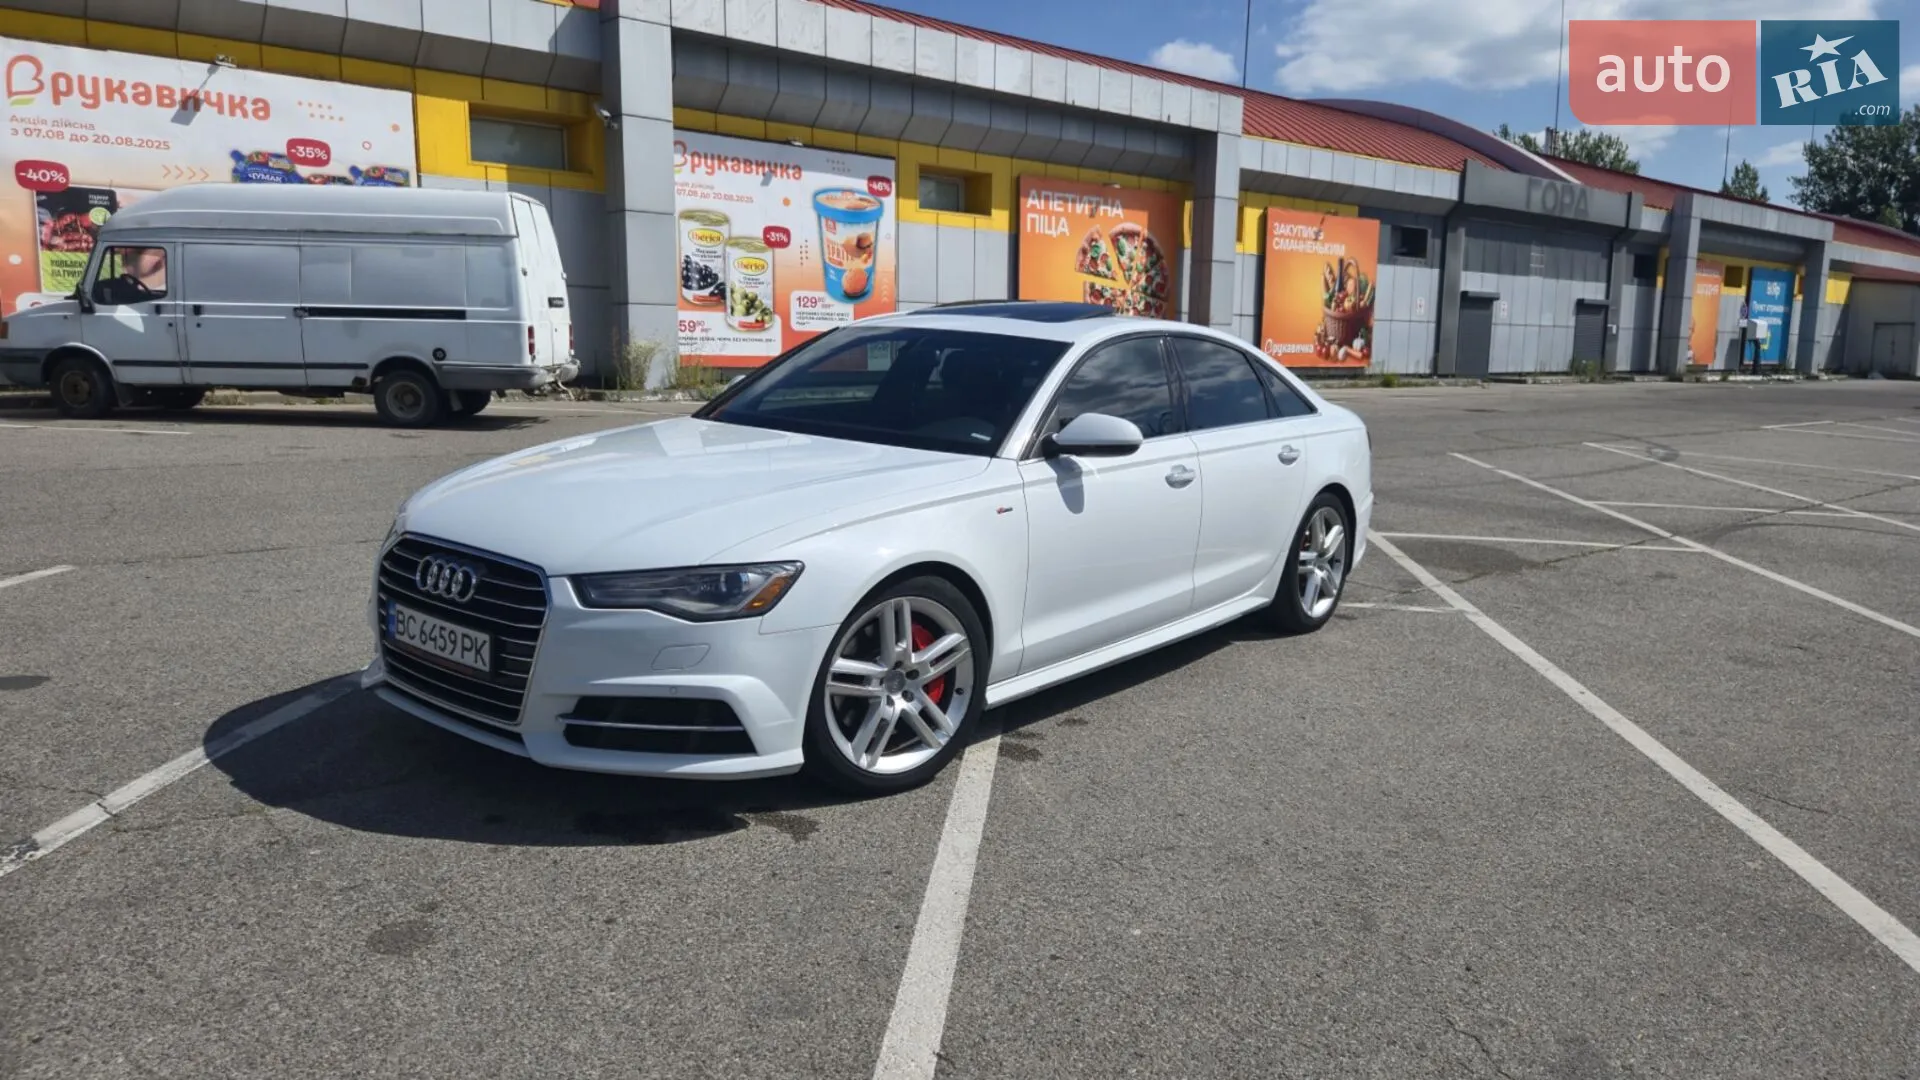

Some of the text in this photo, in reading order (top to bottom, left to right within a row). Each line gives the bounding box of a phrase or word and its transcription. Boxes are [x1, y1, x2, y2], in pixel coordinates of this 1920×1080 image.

[23, 127, 65, 141] 07.08
[92, 132, 171, 151] 20.08.2025
[289, 146, 328, 161] -35%
[19, 169, 66, 184] -40%
[1026, 189, 1125, 219] АПЕТИТНА
[1026, 212, 1070, 238] ПІЦА
[796, 295, 818, 309] 129
[419, 620, 457, 656] 6459
